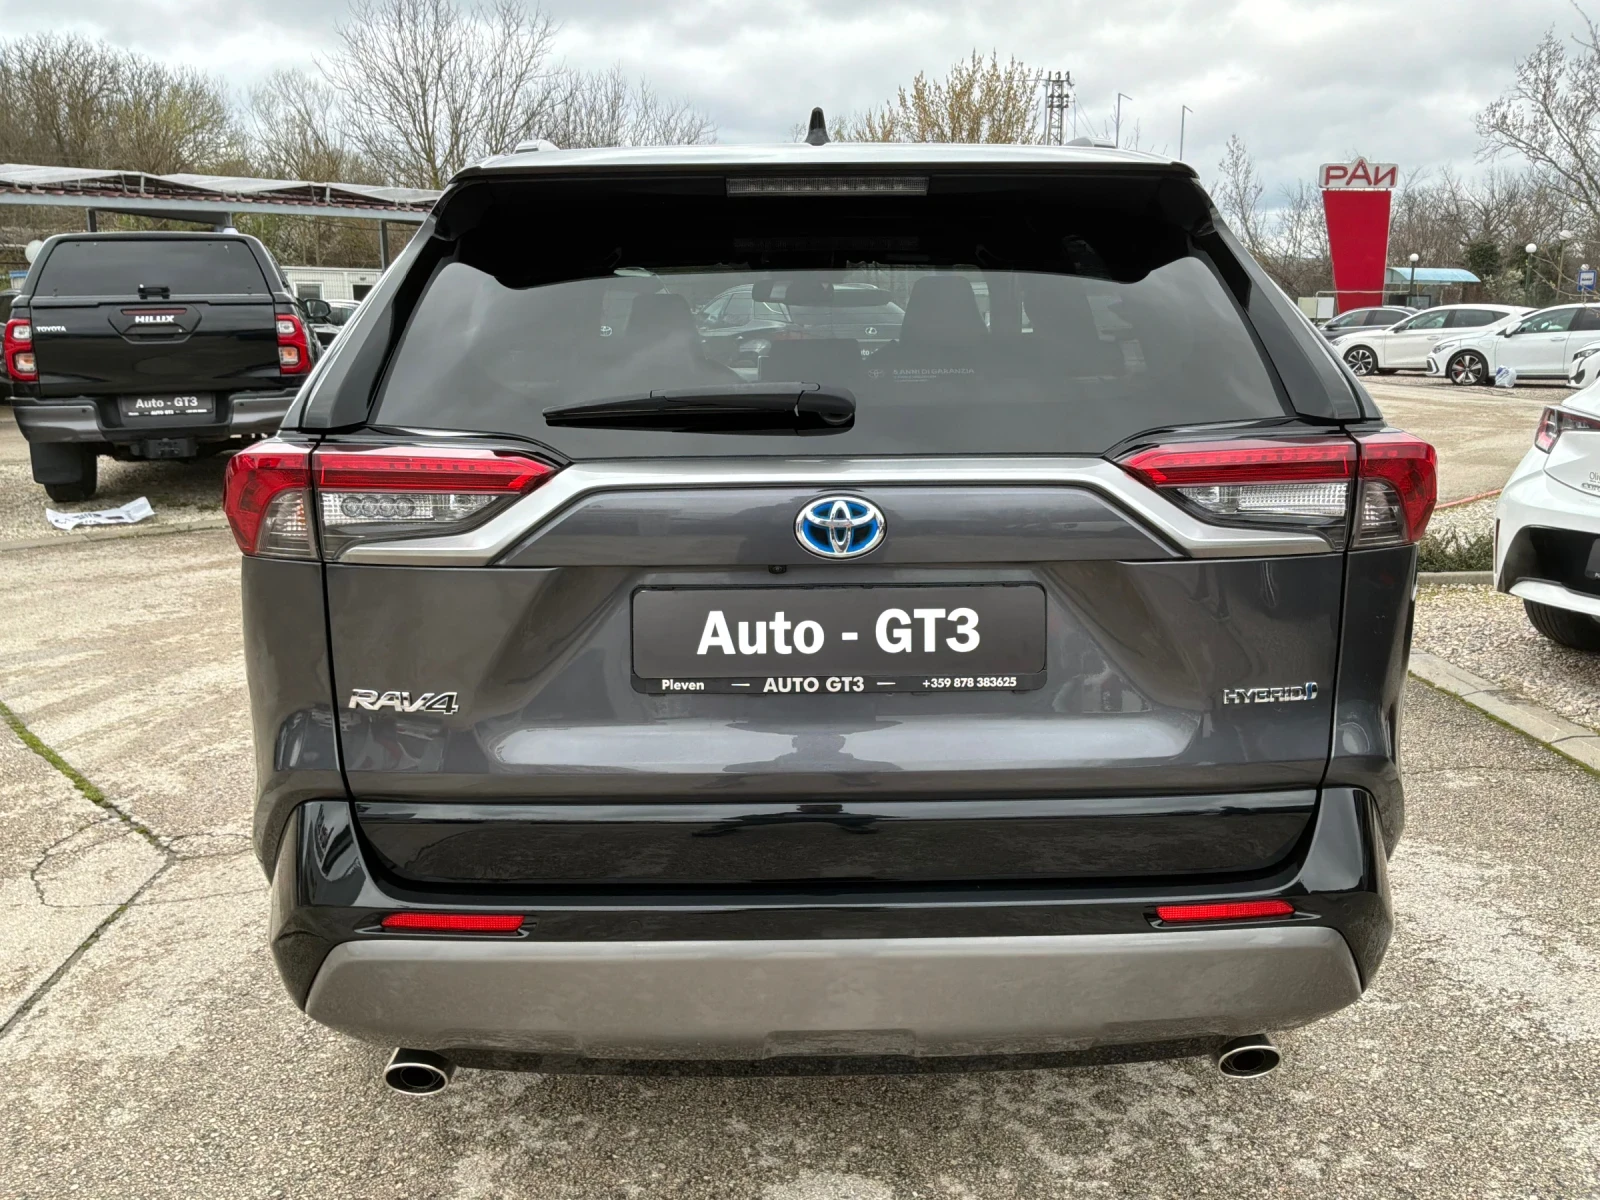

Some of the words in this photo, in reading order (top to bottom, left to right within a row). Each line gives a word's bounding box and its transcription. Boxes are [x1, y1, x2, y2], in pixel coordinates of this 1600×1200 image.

[135, 315, 175, 323] HILUX
[135, 398, 165, 408] Auto
[174, 396, 198, 407] GT3
[696, 610, 825, 655] Auto
[875, 607, 981, 654] GT3
[661, 678, 705, 691] Pleven
[763, 677, 820, 693] AUTO
[826, 677, 865, 693] GT3
[922, 678, 951, 688] +359
[953, 678, 975, 688] 878
[976, 676, 1017, 688] 383625
[348, 688, 459, 715] RAV4
[1223, 686, 1304, 704] HYBRID
